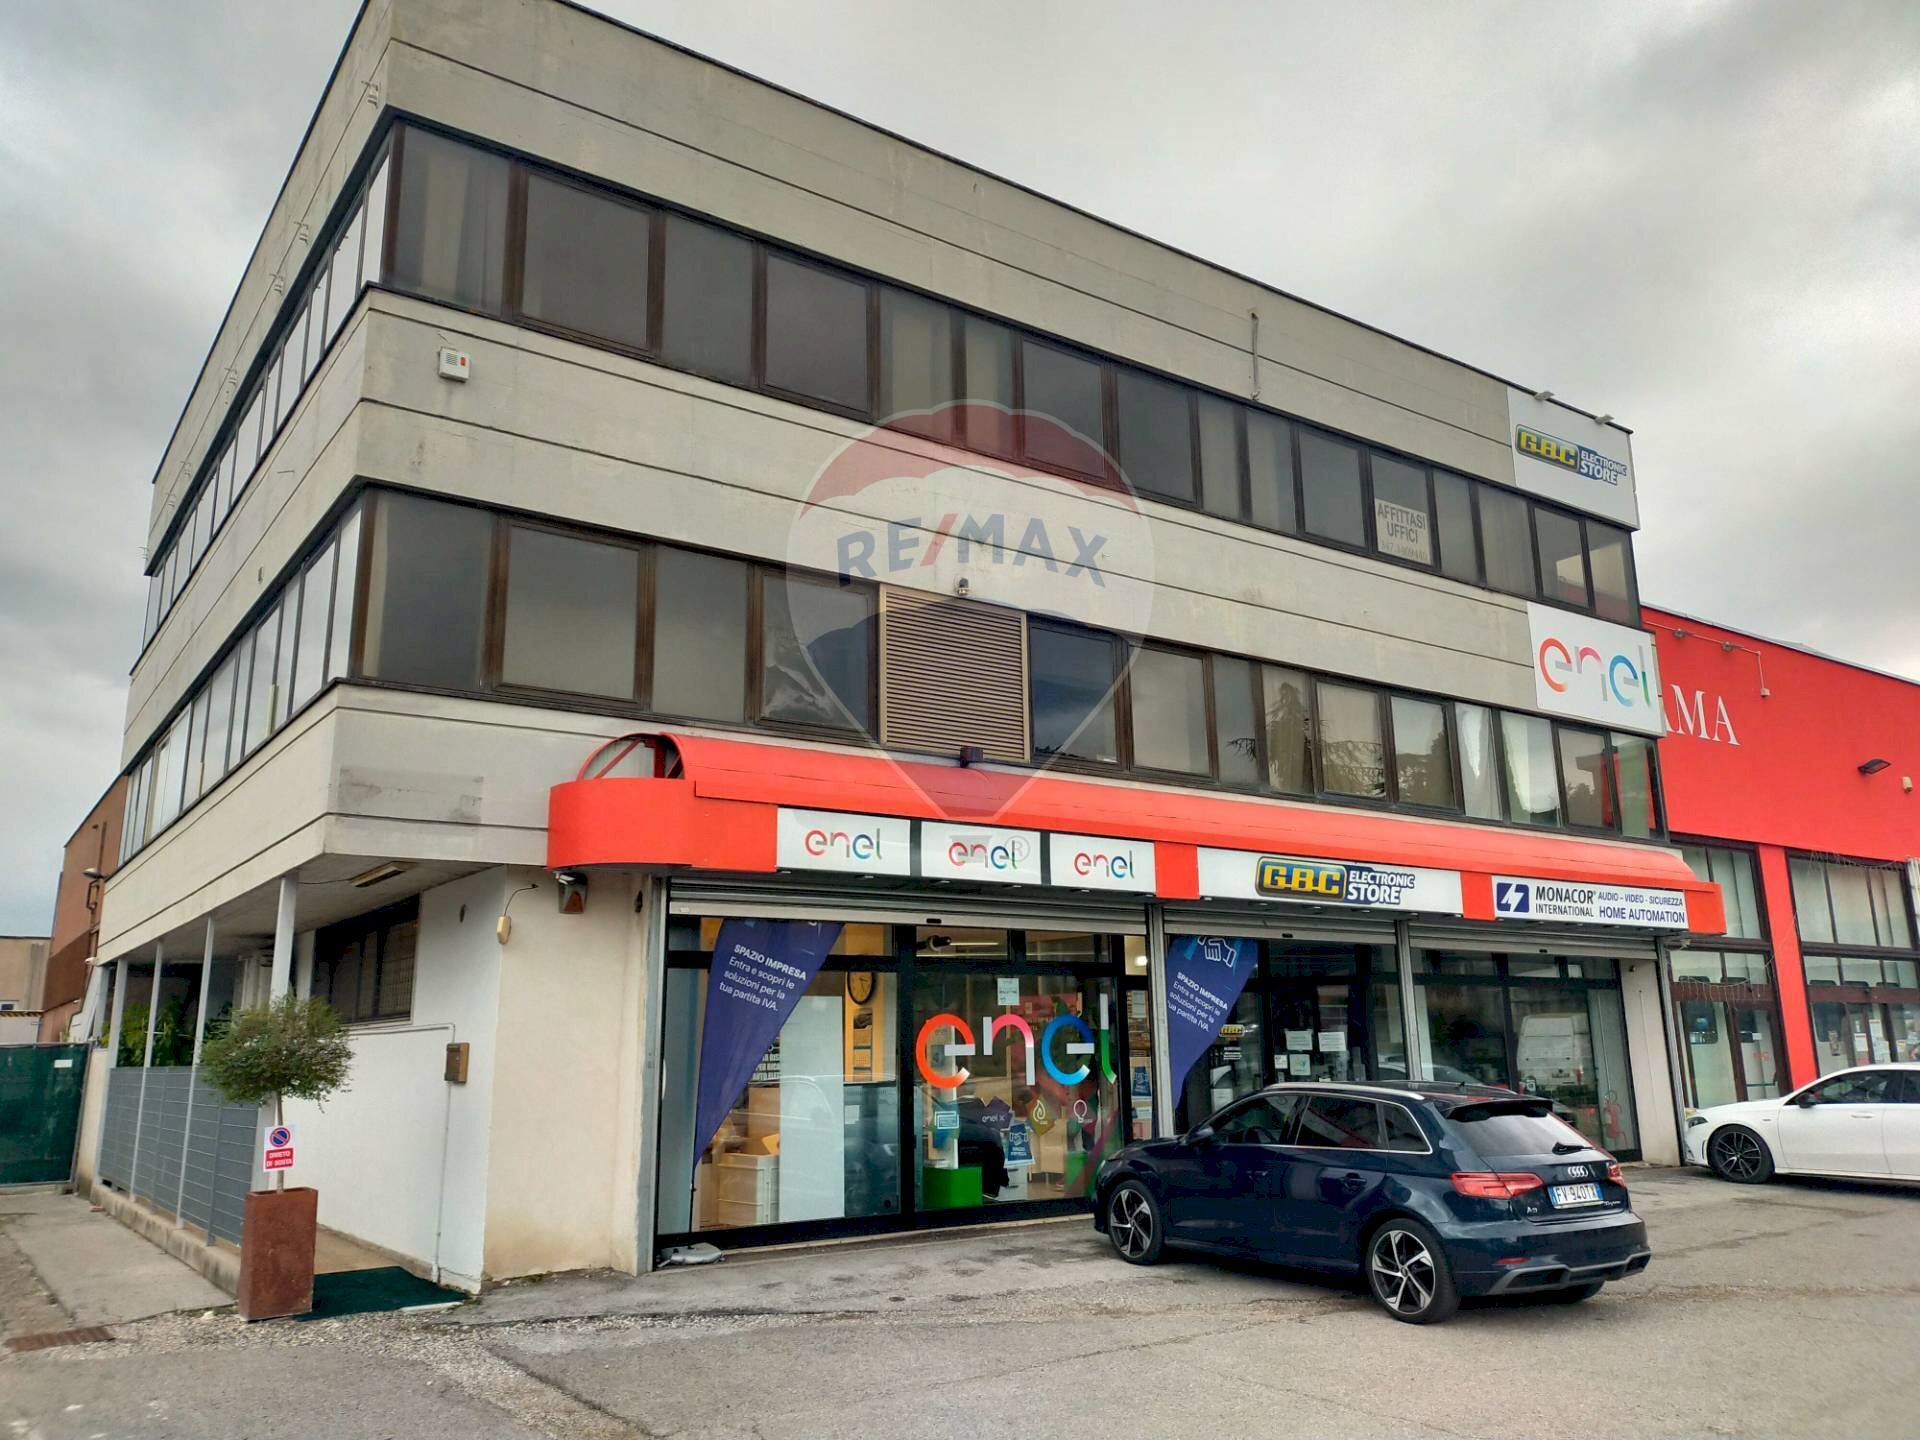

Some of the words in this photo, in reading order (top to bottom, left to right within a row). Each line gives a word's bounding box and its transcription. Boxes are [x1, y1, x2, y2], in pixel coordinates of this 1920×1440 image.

[1580, 461, 1618, 484] STORE
[1581, 450, 1627, 476] ELECTRONIC
[1377, 502, 1426, 531] AFFITTASI
[1387, 522, 1418, 545] UFFICI
[1539, 638, 1651, 708] enel
[804, 828, 882, 860] enel
[948, 840, 1017, 870] enel
[1074, 850, 1135, 880] enel
[1350, 870, 1415, 888] ELECTRONIC
[1347, 884, 1401, 904] STORE
[1598, 891, 1618, 902] AUDIO
[1625, 894, 1644, 904] VIDEO
[1649, 896, 1683, 907] SICUREZZA
[1536, 903, 1594, 918] INTERNATIONAL
[1600, 906, 1626, 919] HOME
[1628, 909, 1685, 923] AUTOMATION
[729, 956, 751, 973] Entra
[758, 970, 786, 985] scopri
[786, 980, 795, 990] le
[734, 944, 765, 963] SPAZIO
[765, 957, 807, 981] IMPRESA
[719, 981, 734, 994] tua
[732, 988, 761, 1006] partita
[762, 998, 779, 1012] IVA.
[724, 970, 761, 990] soluzioni
[760, 984, 776, 996] per
[777, 991, 786, 1000] la
[1173, 981, 1190, 996] Entra
[1195, 996, 1215, 1013] scopri
[1177, 971, 1200, 991] SPAZIO
[1199, 986, 1228, 1011] IMPRESA
[1169, 991, 1196, 1012] soluzioni
[1196, 1008, 1208, 1019] per
[1176, 1007, 1198, 1024] partita
[915, 993, 1118, 1089] enel
